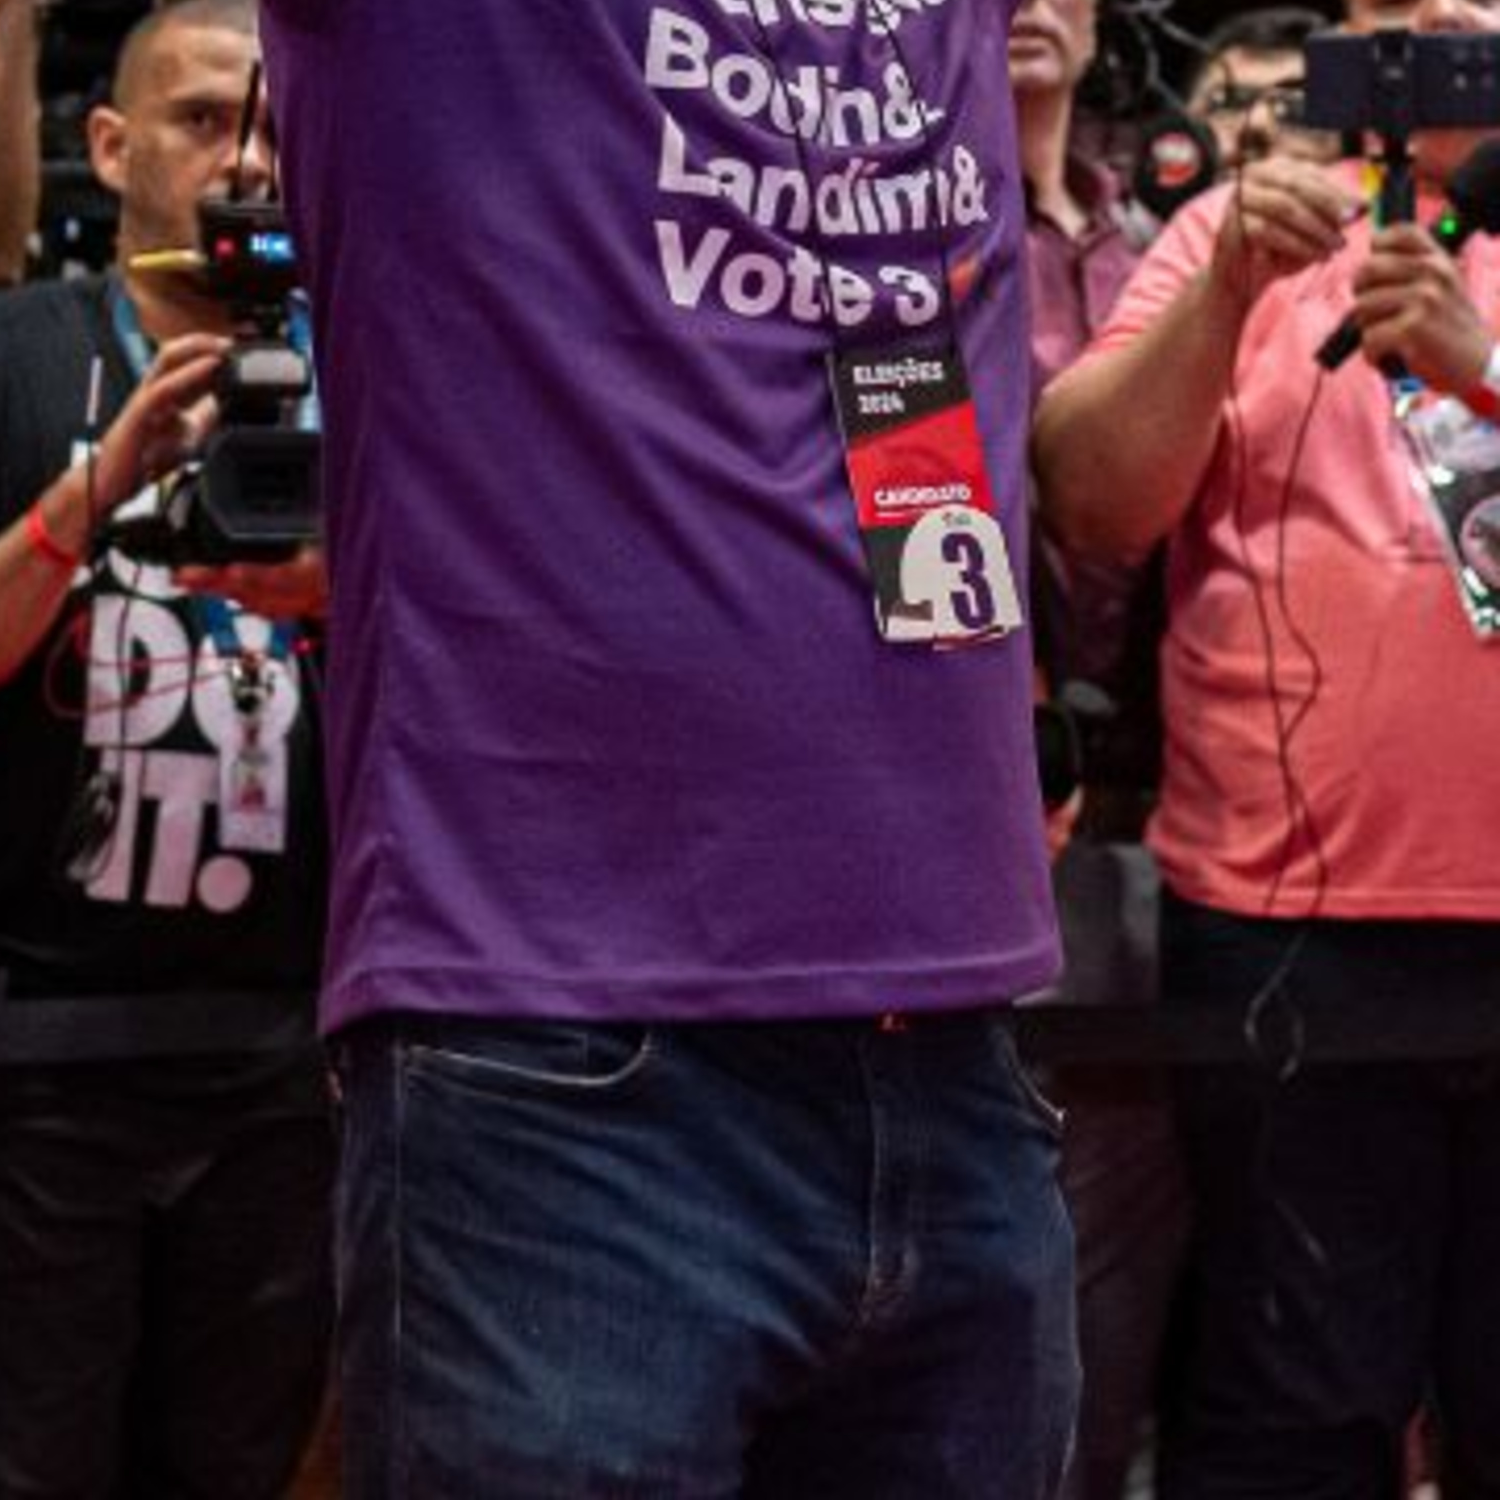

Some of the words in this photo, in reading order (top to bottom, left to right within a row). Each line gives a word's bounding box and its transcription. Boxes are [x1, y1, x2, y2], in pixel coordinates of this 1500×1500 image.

[653, 218, 875, 327] Vote
[852, 357, 946, 388] ELEIÇÕES
[940, 531, 997, 630] 3
